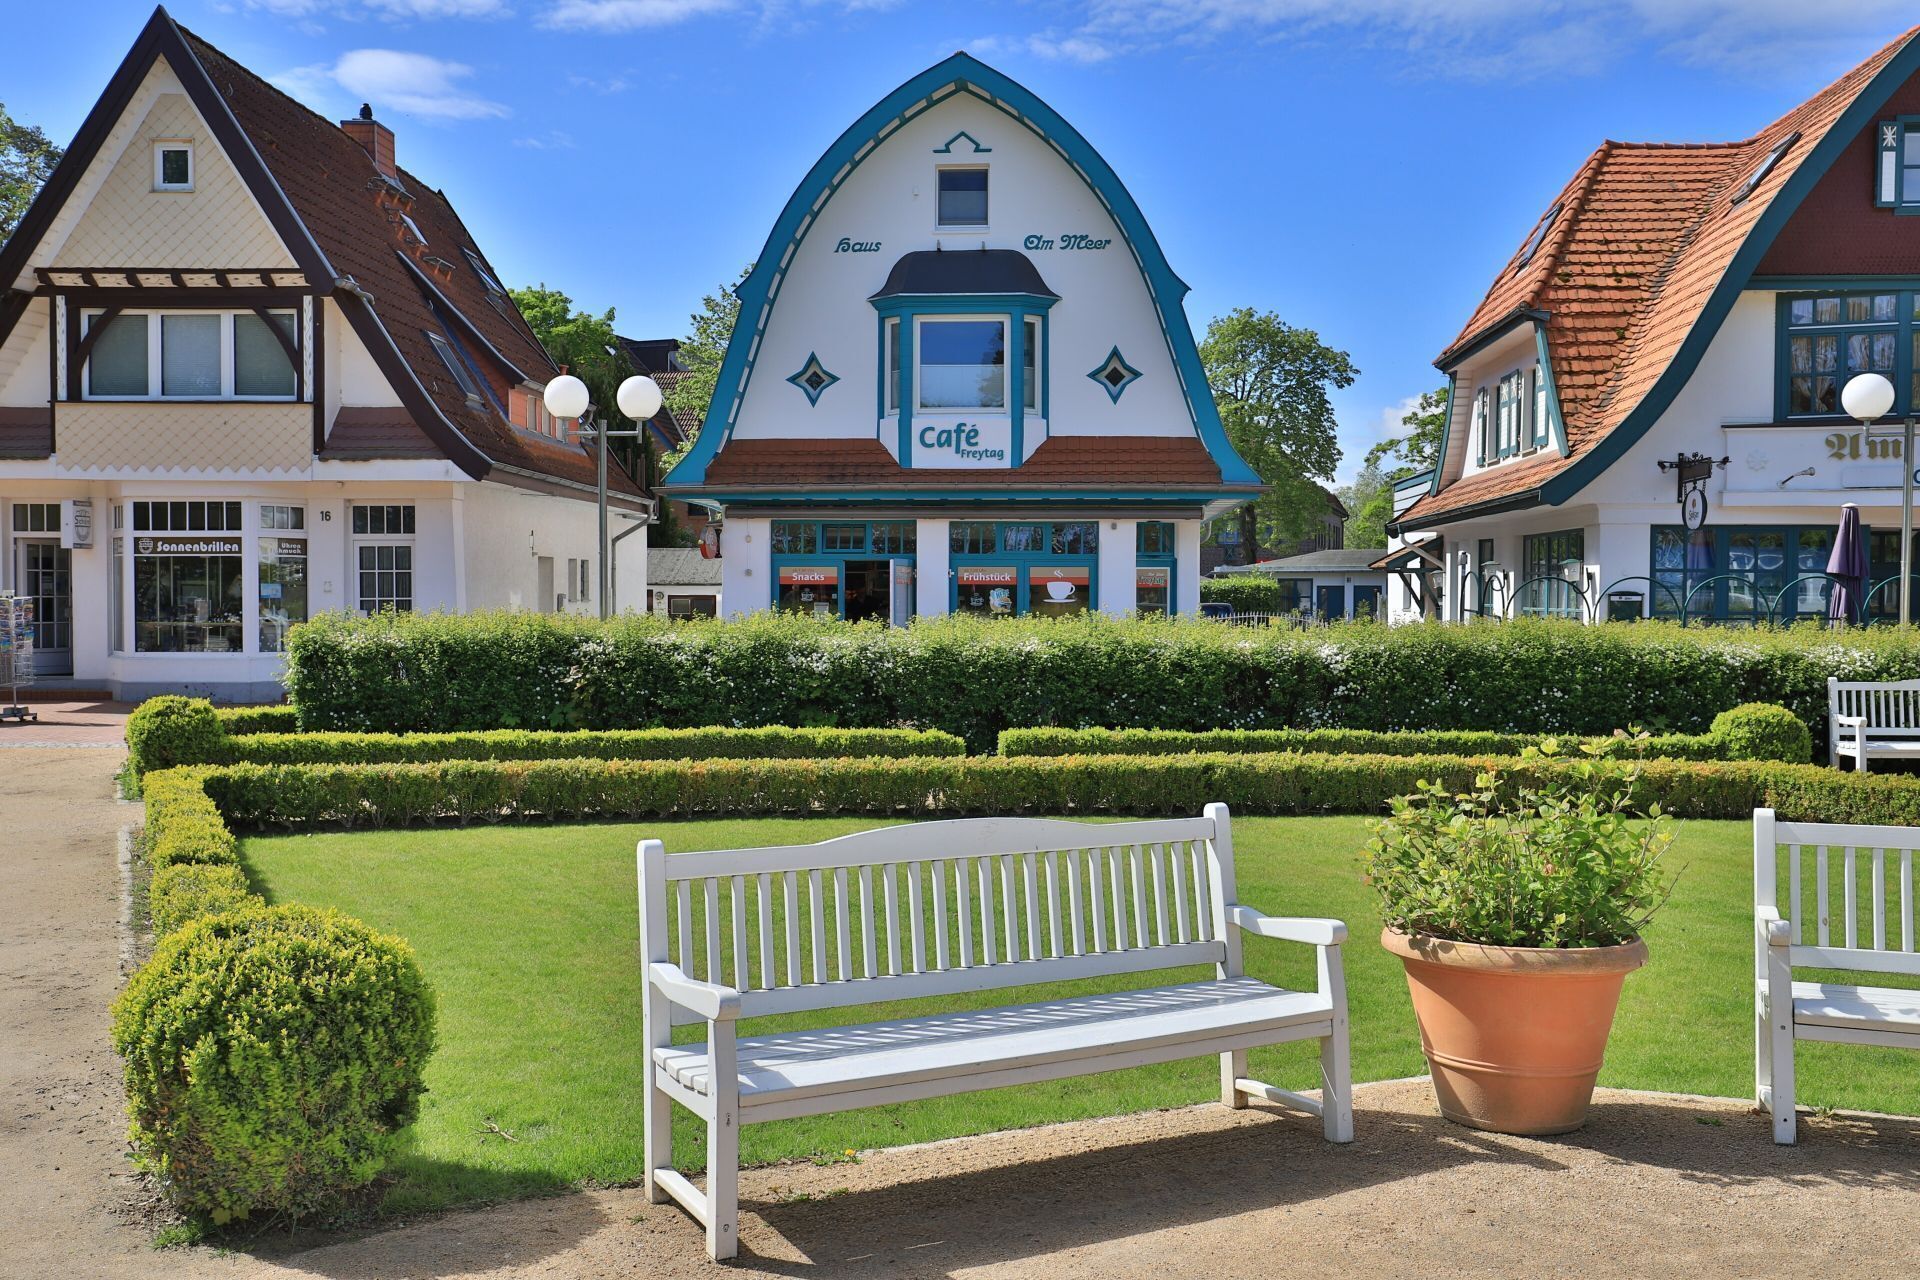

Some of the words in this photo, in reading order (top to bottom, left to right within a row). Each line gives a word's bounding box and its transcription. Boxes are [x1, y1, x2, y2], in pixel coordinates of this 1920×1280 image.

[1023, 234, 1054, 251] Am
[1059, 234, 1112, 251] Meer
[919, 423, 979, 454] Café
[1824, 432, 1903, 461] Am
[961, 448, 1004, 461] Freytag
[319, 510, 332, 522] 16
[156, 541, 239, 552] Sonnenbrillen
[792, 572, 825, 581] Snacks
[963, 572, 1011, 582] Frühstück
